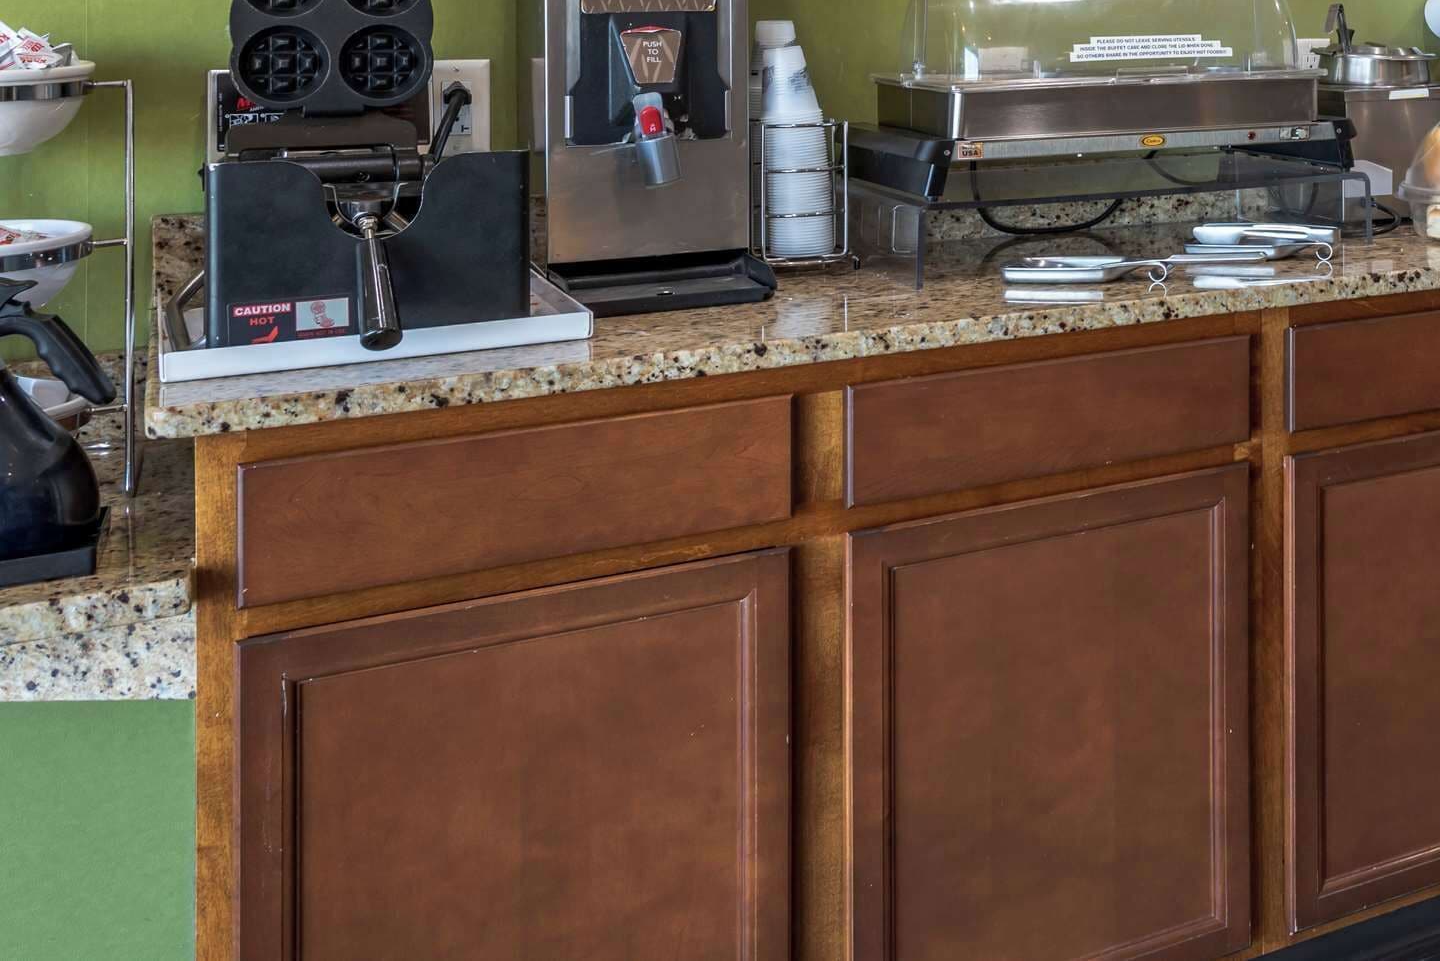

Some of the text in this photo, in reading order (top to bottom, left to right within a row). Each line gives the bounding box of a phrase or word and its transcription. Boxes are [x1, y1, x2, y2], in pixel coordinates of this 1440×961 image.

[648, 48, 659, 56] TO
[962, 149, 979, 157] USA
[234, 302, 291, 317] CAUTION
[250, 317, 276, 326] HOT
